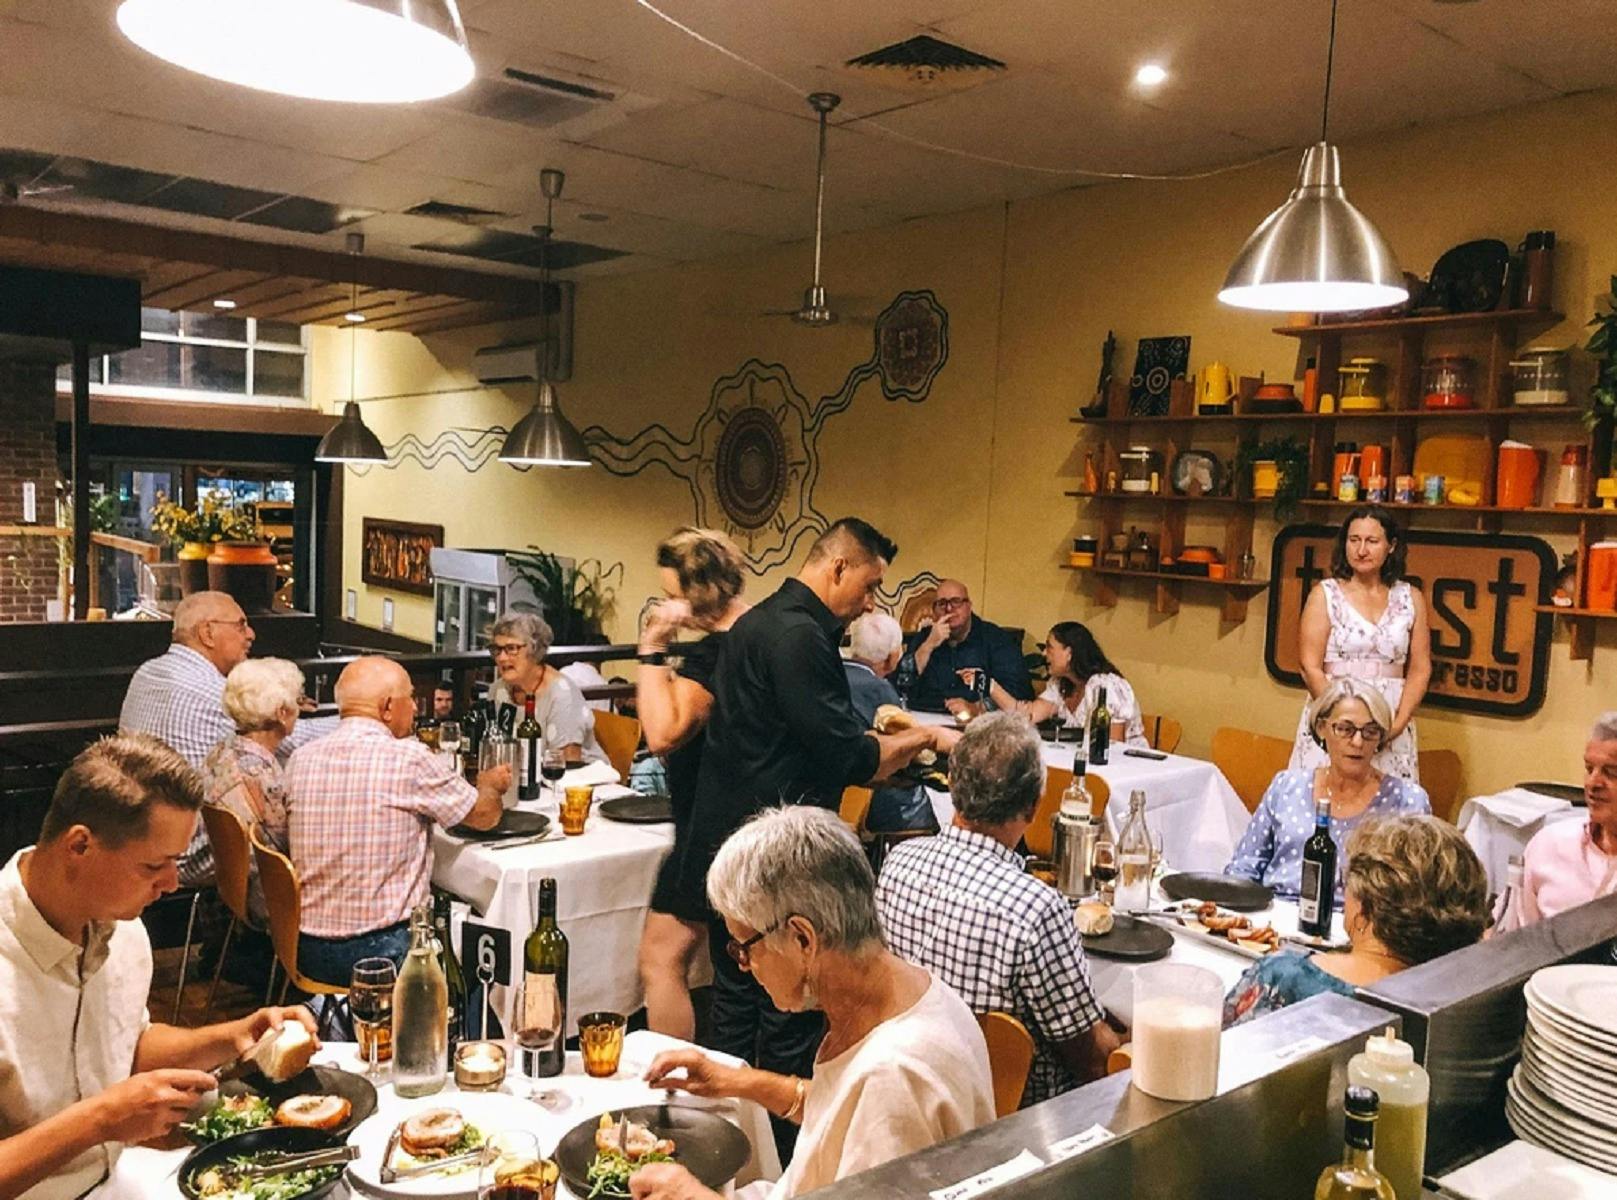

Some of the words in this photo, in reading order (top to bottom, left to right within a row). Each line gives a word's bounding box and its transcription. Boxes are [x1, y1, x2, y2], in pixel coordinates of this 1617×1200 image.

[1295, 545, 1525, 665] tst
[978, 673, 987, 691] 3
[1431, 660, 1518, 694] resso
[502, 709, 510, 731] 2
[477, 933, 496, 971] 6
